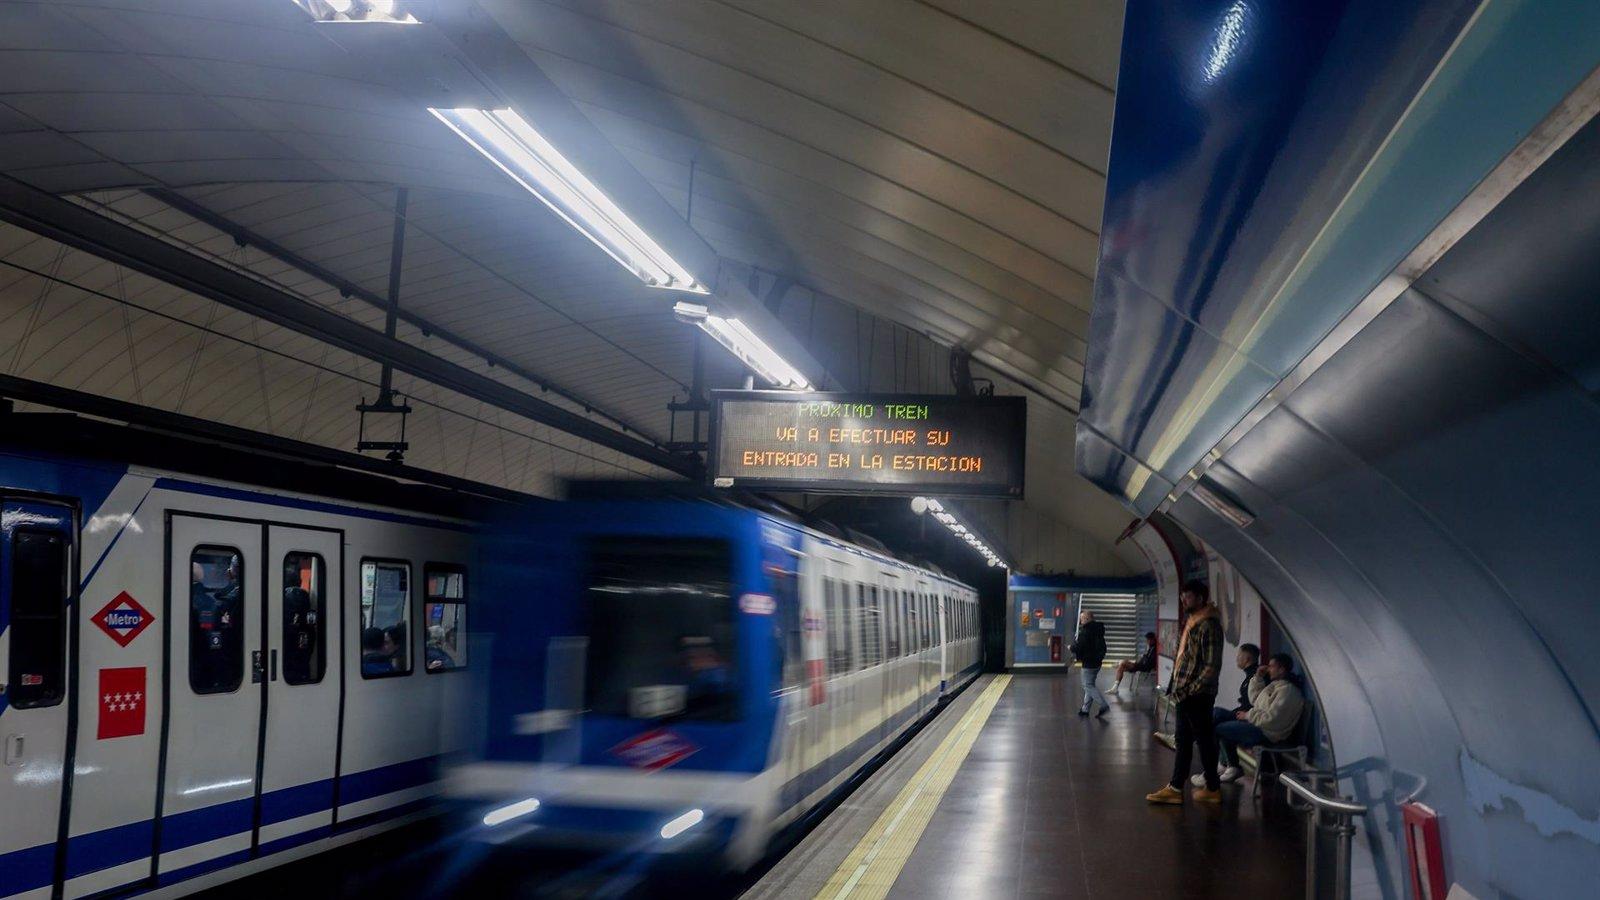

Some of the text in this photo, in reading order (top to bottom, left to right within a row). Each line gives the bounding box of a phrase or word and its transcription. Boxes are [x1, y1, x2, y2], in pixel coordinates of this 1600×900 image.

[799, 403, 929, 420] PROXIMO TREN
[776, 426, 950, 446] VA A EFECTUAR SU
[743, 451, 982, 472] ENTRADA EN LA ESTACION
[108, 613, 139, 626] Metro
